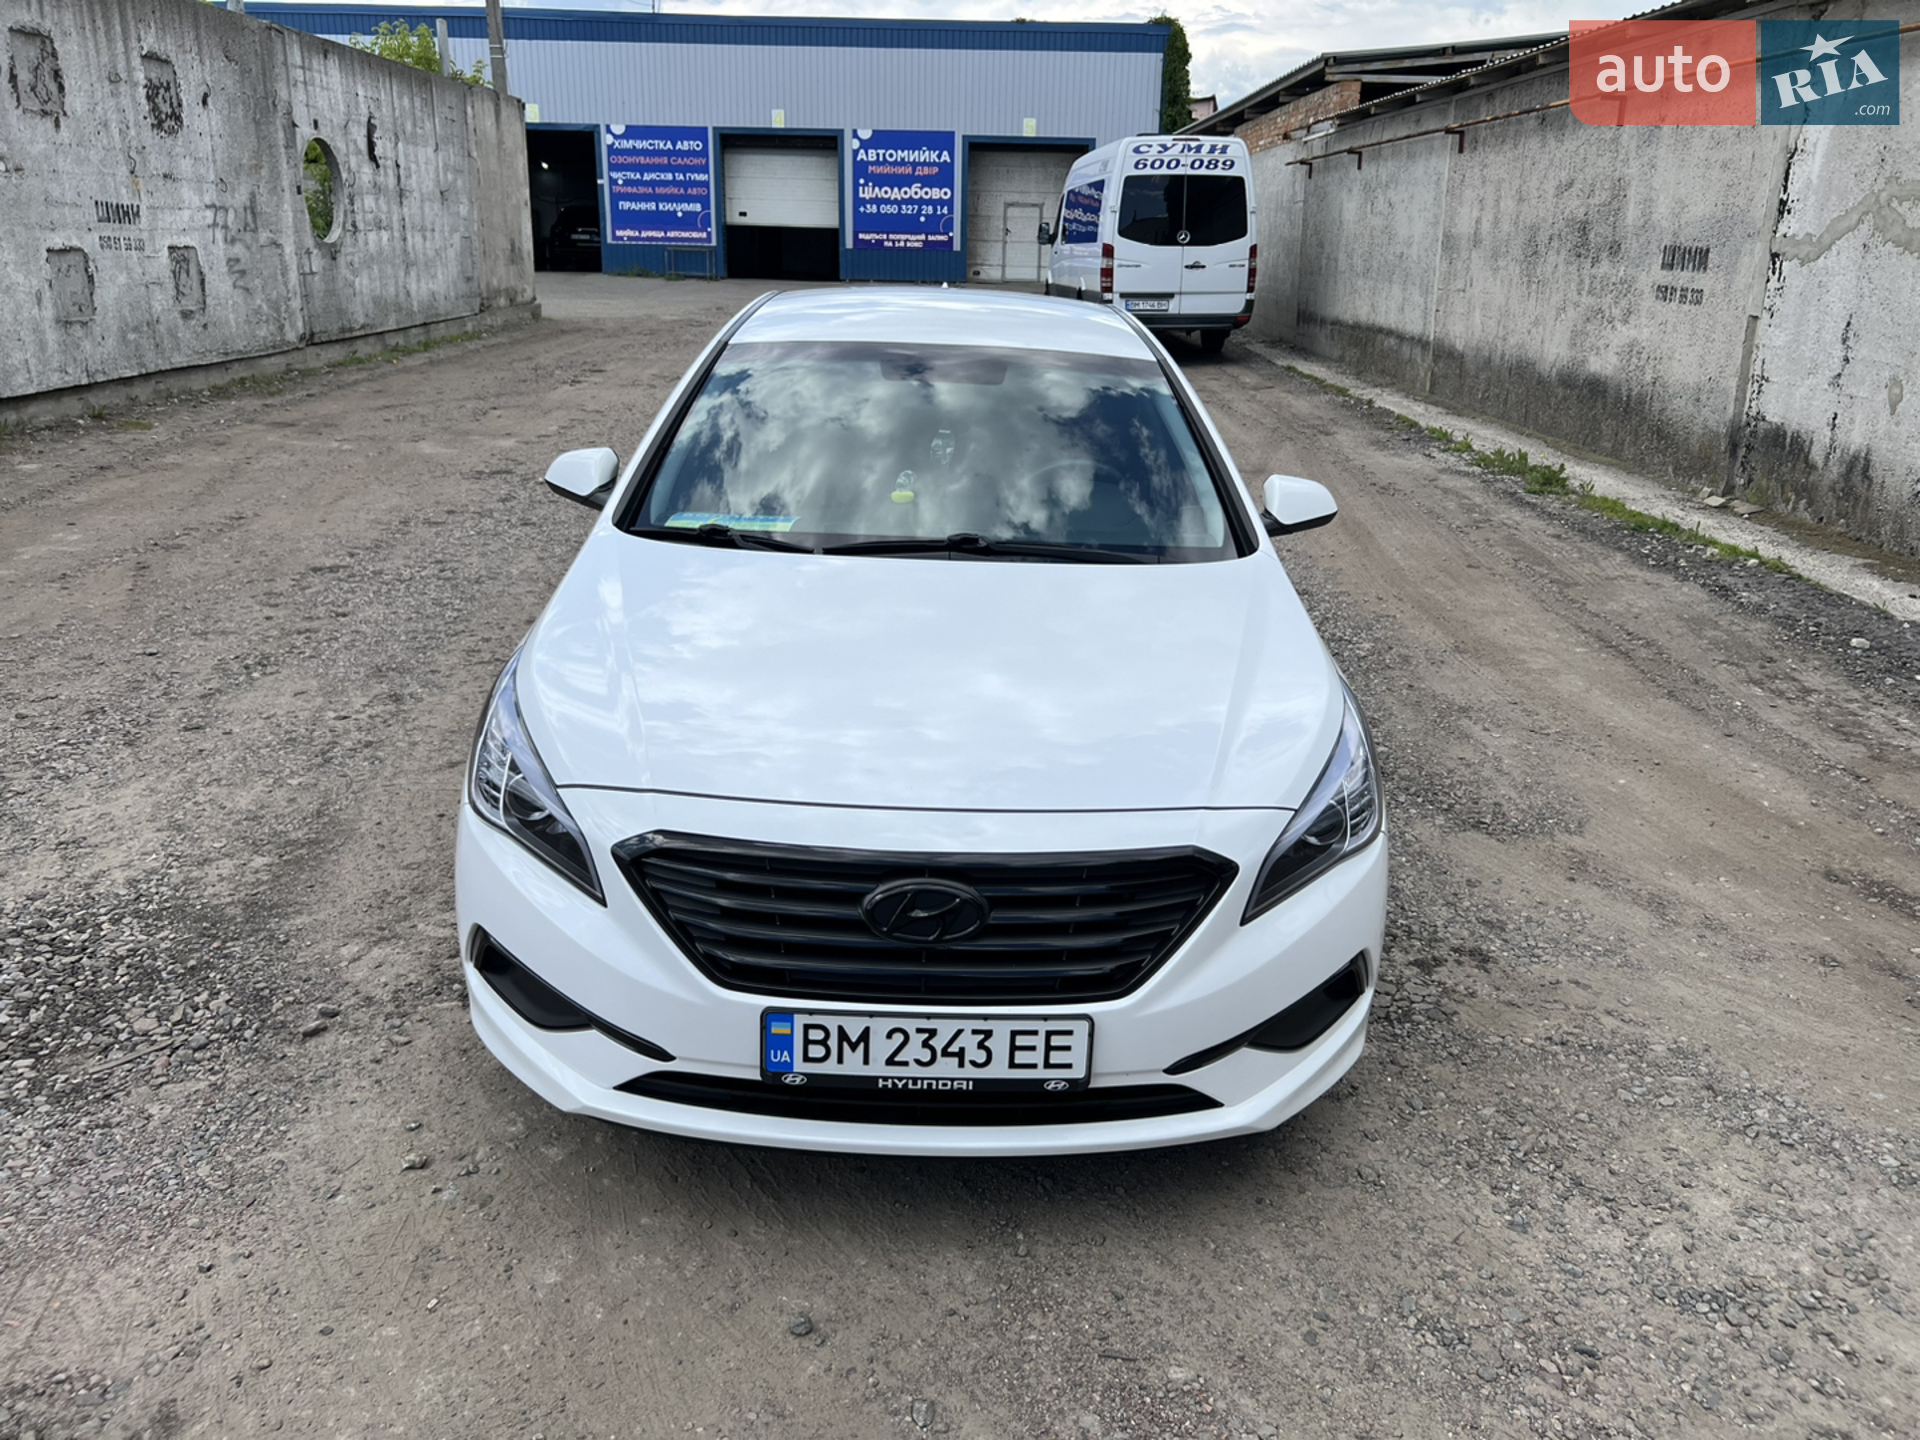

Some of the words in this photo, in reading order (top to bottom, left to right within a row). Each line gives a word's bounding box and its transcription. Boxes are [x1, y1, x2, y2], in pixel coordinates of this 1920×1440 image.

[528, 106, 538, 122] 3
[773, 110, 784, 127] 4
[1024, 119, 1035, 136] 5
[613, 139, 673, 150] ХІМЧИСТКА
[675, 140, 703, 151] АВТО
[609, 155, 668, 165] ОЗОНУВАННЯ
[669, 156, 707, 165] САЛОНУ
[856, 146, 951, 163] АВТОМИЙКА
[867, 163, 914, 175] МИЙНИЙ
[914, 166, 940, 176] ДВІР
[1133, 158, 1236, 171] 600-089
[609, 171, 642, 180] ЧИСТКА
[643, 172, 673, 182] ДИСКІВ
[674, 173, 685, 181] ТА
[686, 172, 709, 182] ГУМИ
[612, 185, 654, 195] ТРИФАЗНА
[655, 185, 685, 195] МИЙКА
[686, 187, 708, 196] АВТО
[618, 200, 657, 211] ПРАННЯ
[658, 202, 702, 212] КИЛИМІВ
[858, 203, 878, 214] +38
[879, 204, 899, 215] 050
[900, 204, 919, 215] 327
[920, 205, 934, 215] 28
[935, 205, 949, 215] 14
[802, 1023, 871, 1066] BM
[884, 1026, 994, 1069] 2343
[1007, 1029, 1074, 1070] EE
[770, 1050, 791, 1063] UA
[878, 1078, 974, 1091] HYUNDAI
